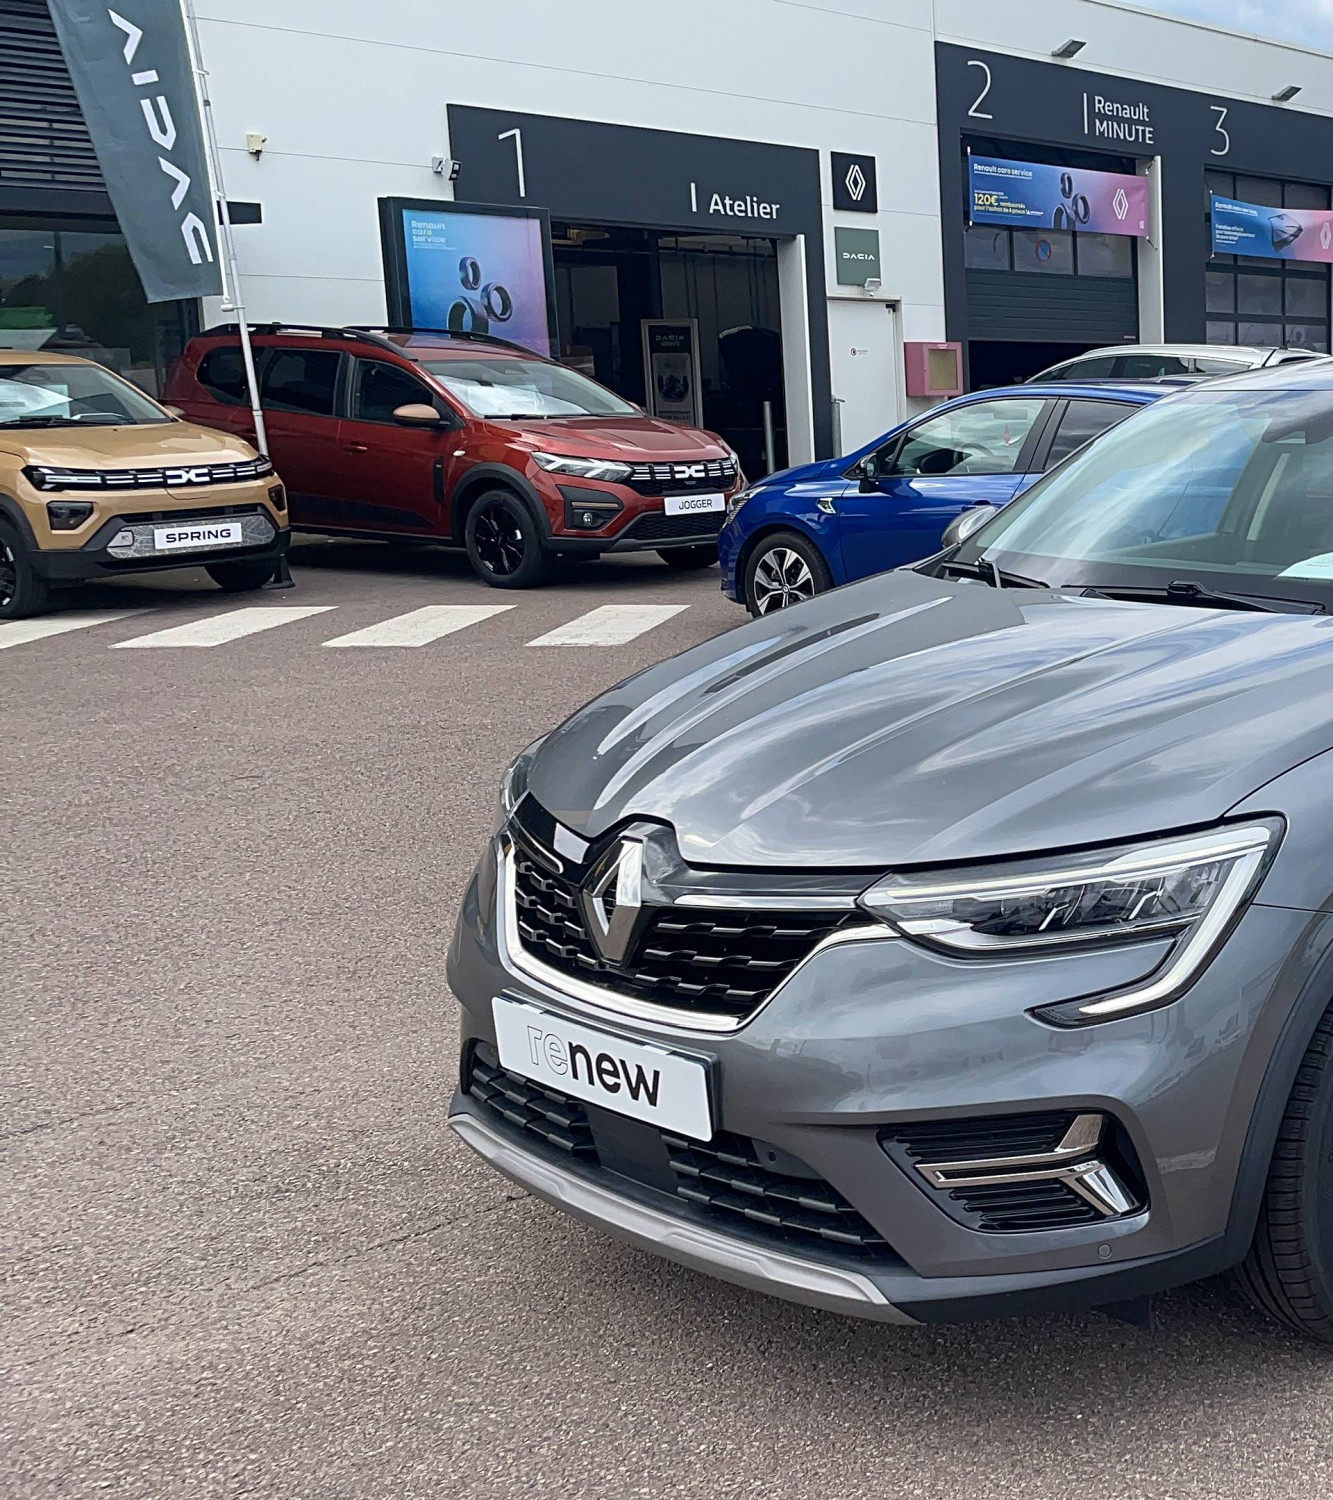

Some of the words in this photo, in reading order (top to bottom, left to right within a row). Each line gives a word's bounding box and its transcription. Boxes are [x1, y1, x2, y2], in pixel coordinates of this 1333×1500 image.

[967, 60, 993, 119] 2
[1094, 95, 1150, 122] Renault
[1095, 118, 1154, 144] MINUTE
[1210, 105, 1230, 156] 3
[498, 128, 526, 198] 1
[709, 193, 780, 219] Atelier
[974, 193, 999, 206] 120€
[411, 220, 446, 230] Renault
[842, 252, 876, 261] DACIA
[678, 498, 713, 510] JOGGER
[165, 528, 232, 543] SPRING
[526, 1025, 661, 1108] renew
